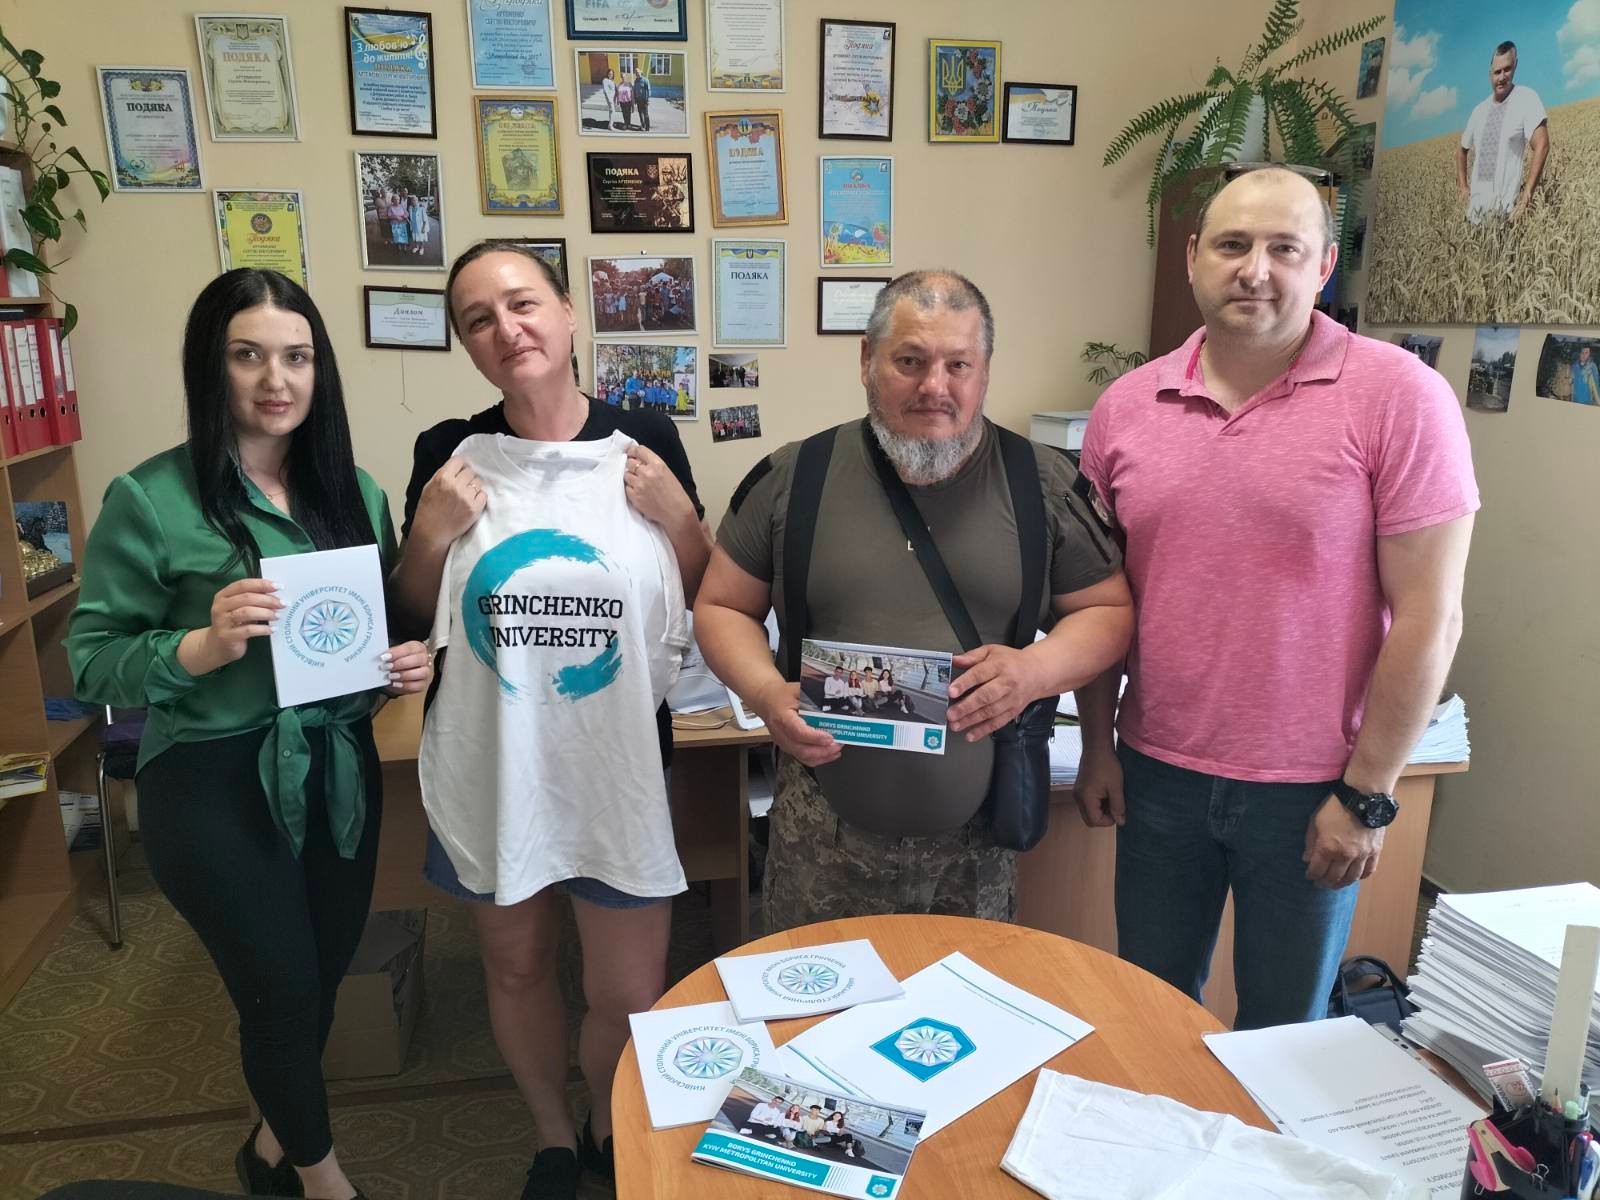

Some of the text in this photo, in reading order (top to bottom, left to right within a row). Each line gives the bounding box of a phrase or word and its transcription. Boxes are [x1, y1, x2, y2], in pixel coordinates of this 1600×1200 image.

[585, 0, 610, 9] FIFA
[222, 52, 271, 62] ПОДЯКА
[363, 53, 375, 64] до
[126, 102, 174, 112] ПОДЯКА
[605, 168, 640, 177] ПОДЯКА
[730, 271, 769, 280] ПОДЯКА
[300, 585, 348, 603] УНІВЕРСИТЕТ
[477, 594, 624, 619] GRINCHENKO
[818, 721, 837, 729] BORYS
[856, 732, 888, 740] UNIVERSITY
[671, 1025, 726, 1041] УНІВЕРСИТЕТ
[725, 1027, 748, 1040] ІМЕНІ
[656, 1039, 671, 1074] СТОЛИЧНИЙ
[662, 1072, 706, 1091] КИЇВСЬКИЙ
[726, 1141, 797, 1168] BORYS GRINCHENKO
[702, 1143, 818, 1180] KYIV METROPOLITAN UNIVERSITY
